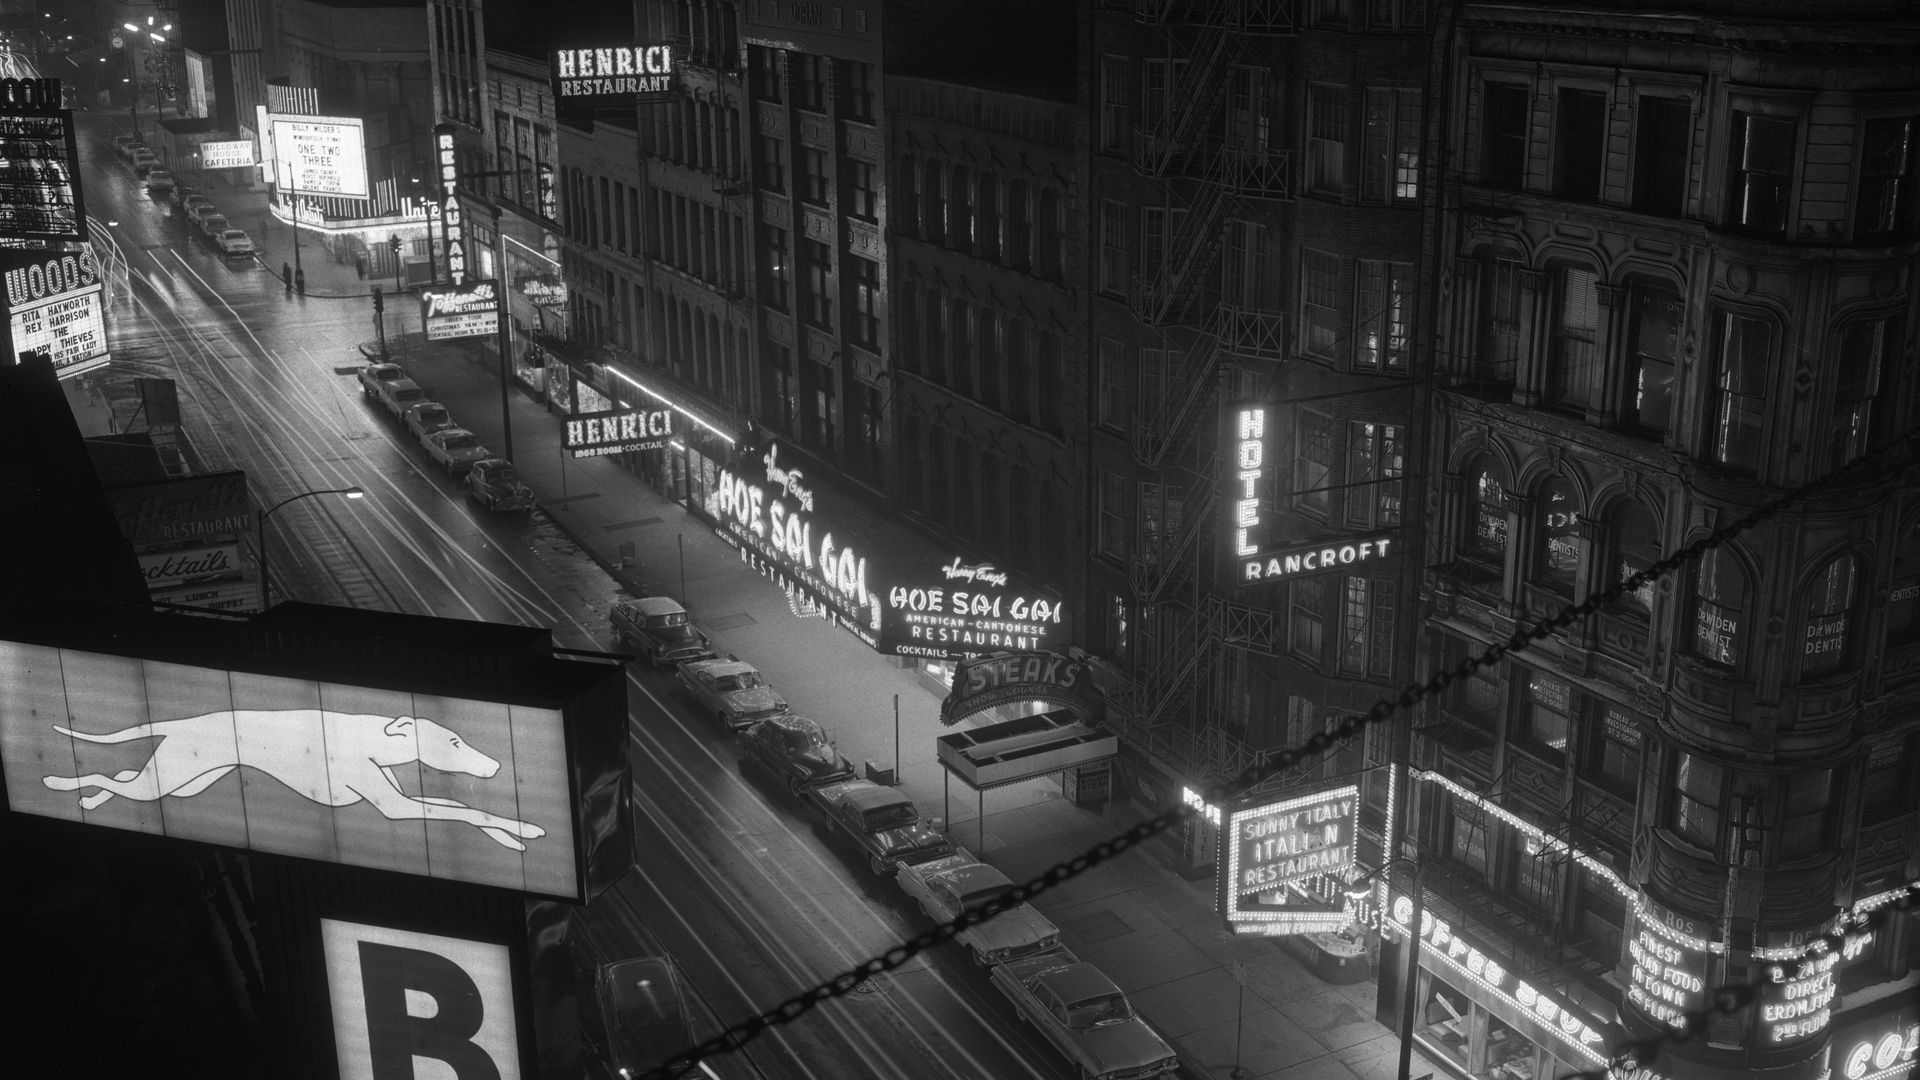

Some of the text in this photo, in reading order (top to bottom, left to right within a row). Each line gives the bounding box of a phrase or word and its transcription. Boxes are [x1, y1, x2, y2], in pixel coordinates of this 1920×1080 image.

[557, 45, 671, 78] HENRICI
[561, 76, 670, 96] RESTAURANT
[203, 142, 250, 151] HOLLOWAY
[298, 144, 340, 156] ONE TWO
[205, 157, 251, 167] CAFETERIA
[303, 155, 333, 167] THREE
[440, 135, 464, 286] RESTAURANT
[5, 251, 94, 305] WOODS
[22, 296, 90, 323] RITA HAYWORTH
[455, 301, 497, 313] RESTAURANT
[25, 308, 89, 335] REX HARRISON
[27, 343, 52, 357] APPY
[66, 346, 80, 356] FAIR
[82, 340, 97, 351] LADY
[566, 410, 672, 446] HENRICI
[625, 441, 664, 451] COCKTAIL
[1238, 409, 1264, 556] HOTEL
[163, 515, 248, 539] RESTAURANT
[719, 469, 869, 608] HOE SAI GAI
[1477, 525, 1507, 544] DENTIST
[1245, 539, 1390, 580] RANCROFT
[1548, 538, 1579, 559] DENTISTS
[729, 522, 857, 618] AMERICAN CANTONESE
[942, 556, 976, 584] Harry
[186, 591, 218, 602] LUNCH
[741, 546, 838, 629] RESTAURANT
[890, 586, 1061, 623] HOE SAI GAI
[906, 614, 1046, 635] AMERICAN CANTONESE
[912, 625, 1039, 649] RESTAURANT
[1697, 624, 1731, 648] DENTIST
[897, 645, 948, 658] COCKTAILS
[968, 656, 1080, 691] STEAKS
[1006, 686, 1048, 696] LOUNGE
[1537, 686, 1563, 702] DETECTIVE
[1605, 717, 1641, 739] INVESTIGATION
[1608, 710, 1629, 724] BUREAU
[1244, 801, 1351, 840] SUNNY ITALY
[1256, 825, 1338, 862] ITALIN
[1244, 846, 1349, 886] RESTAURANT
[1264, 922, 1292, 936] MAIN
[1294, 921, 1338, 935] ENTRANCE
[1640, 931, 1682, 965] FINEST
[1394, 896, 1603, 1044] COFFEE SHOP
[1664, 966, 1701, 992] FOOD
[1632, 964, 1685, 1006] IN TOWN
[1786, 972, 1833, 1000] DIRECT
[357, 940, 501, 1080] B
[1799, 1009, 1831, 1037] FLOOR
